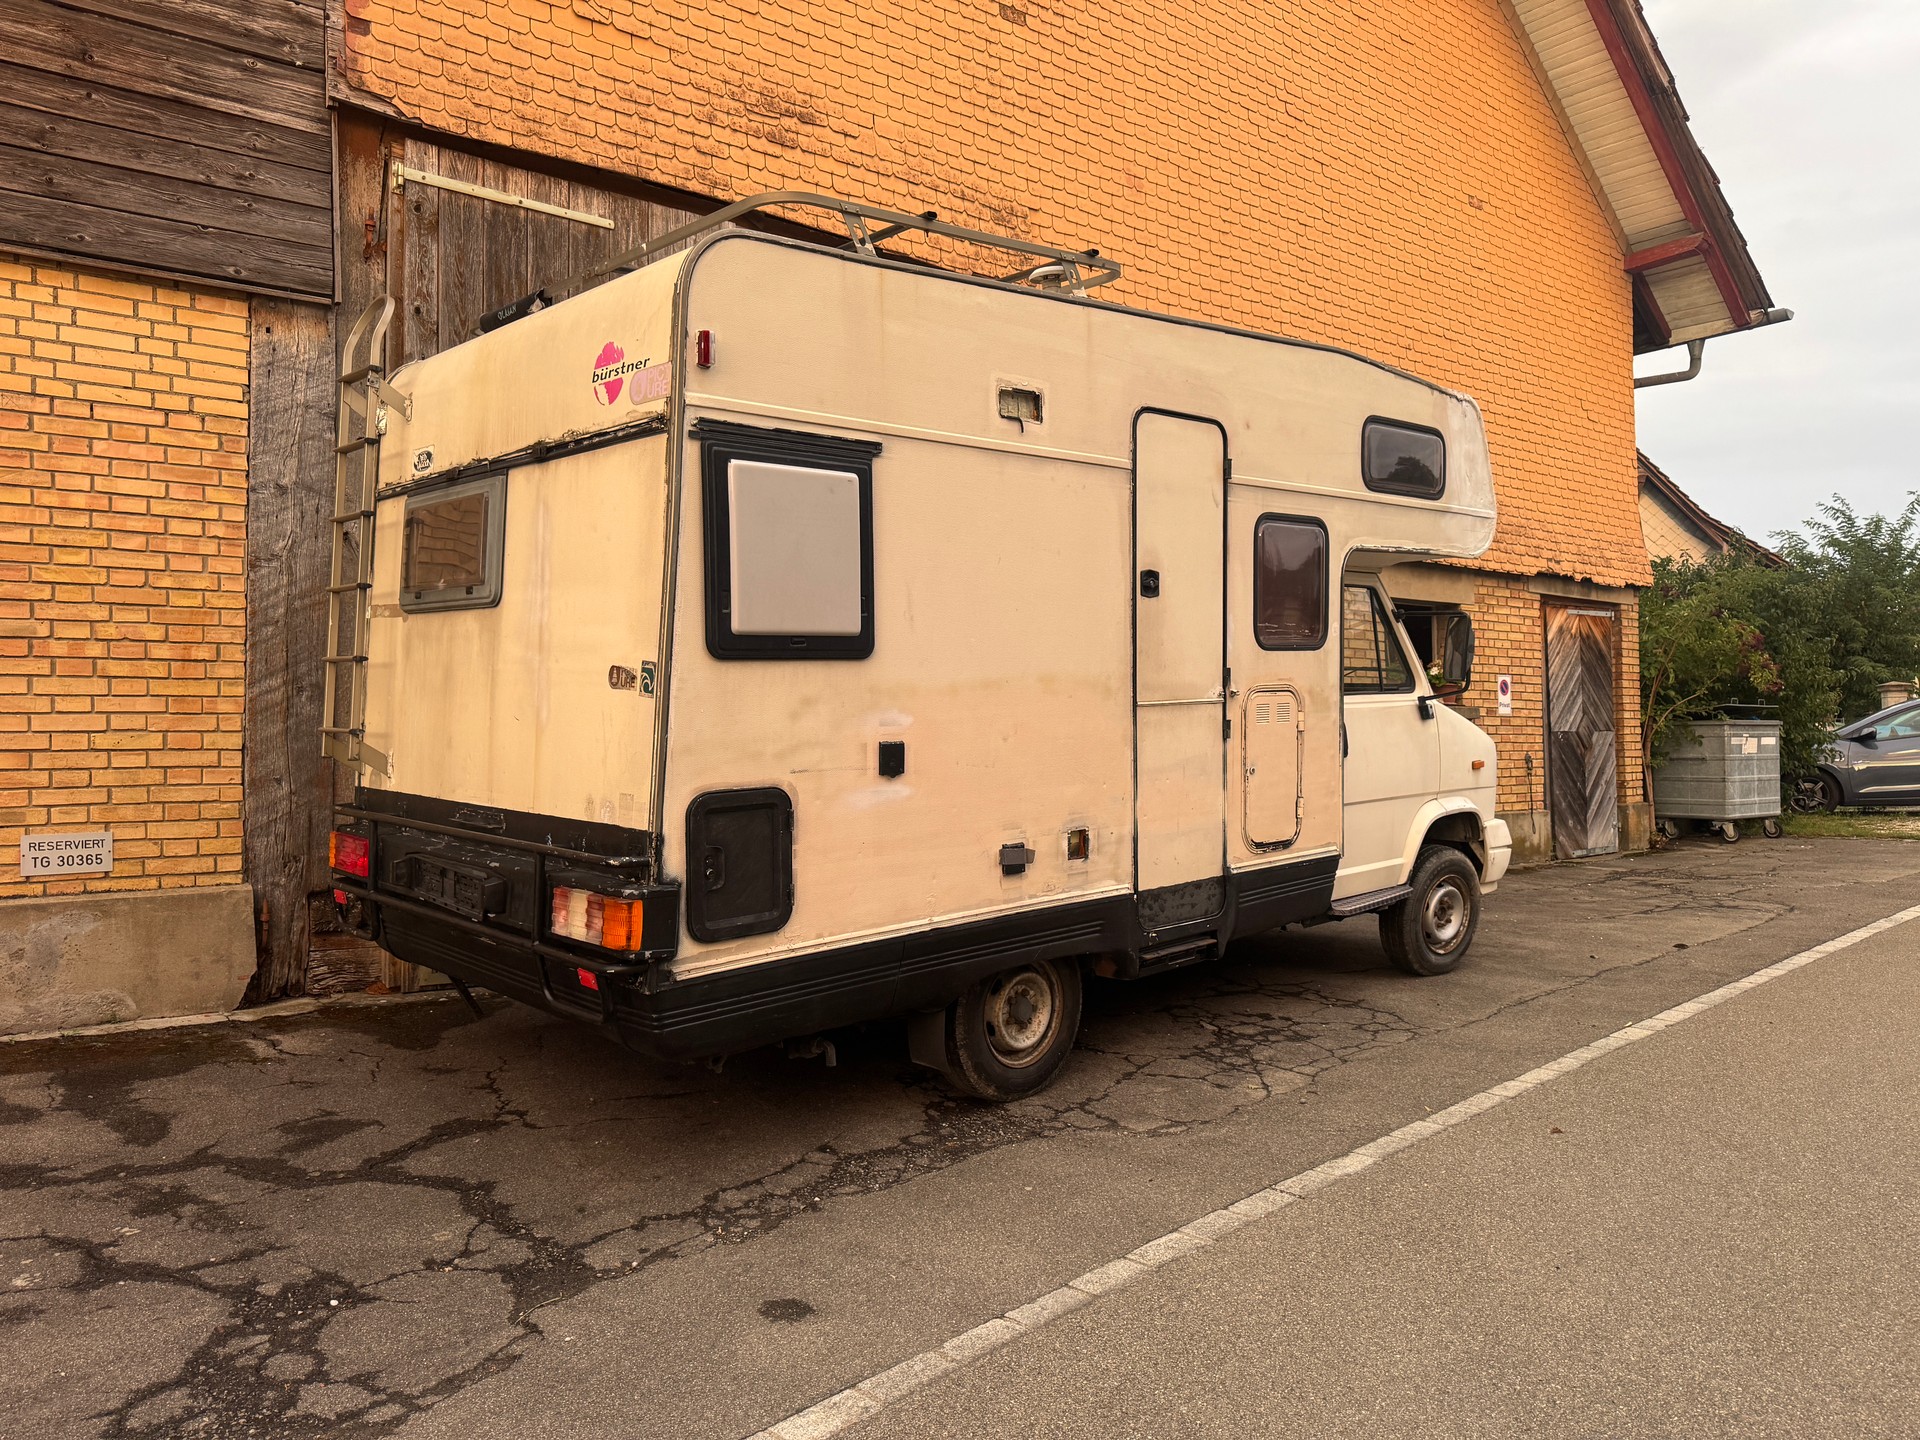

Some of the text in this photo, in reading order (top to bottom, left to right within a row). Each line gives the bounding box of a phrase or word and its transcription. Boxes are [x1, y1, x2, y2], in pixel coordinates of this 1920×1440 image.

[591, 357, 651, 384] bürstner
[28, 838, 106, 852] RESERVIERT
[31, 853, 104, 869] TG 30365
